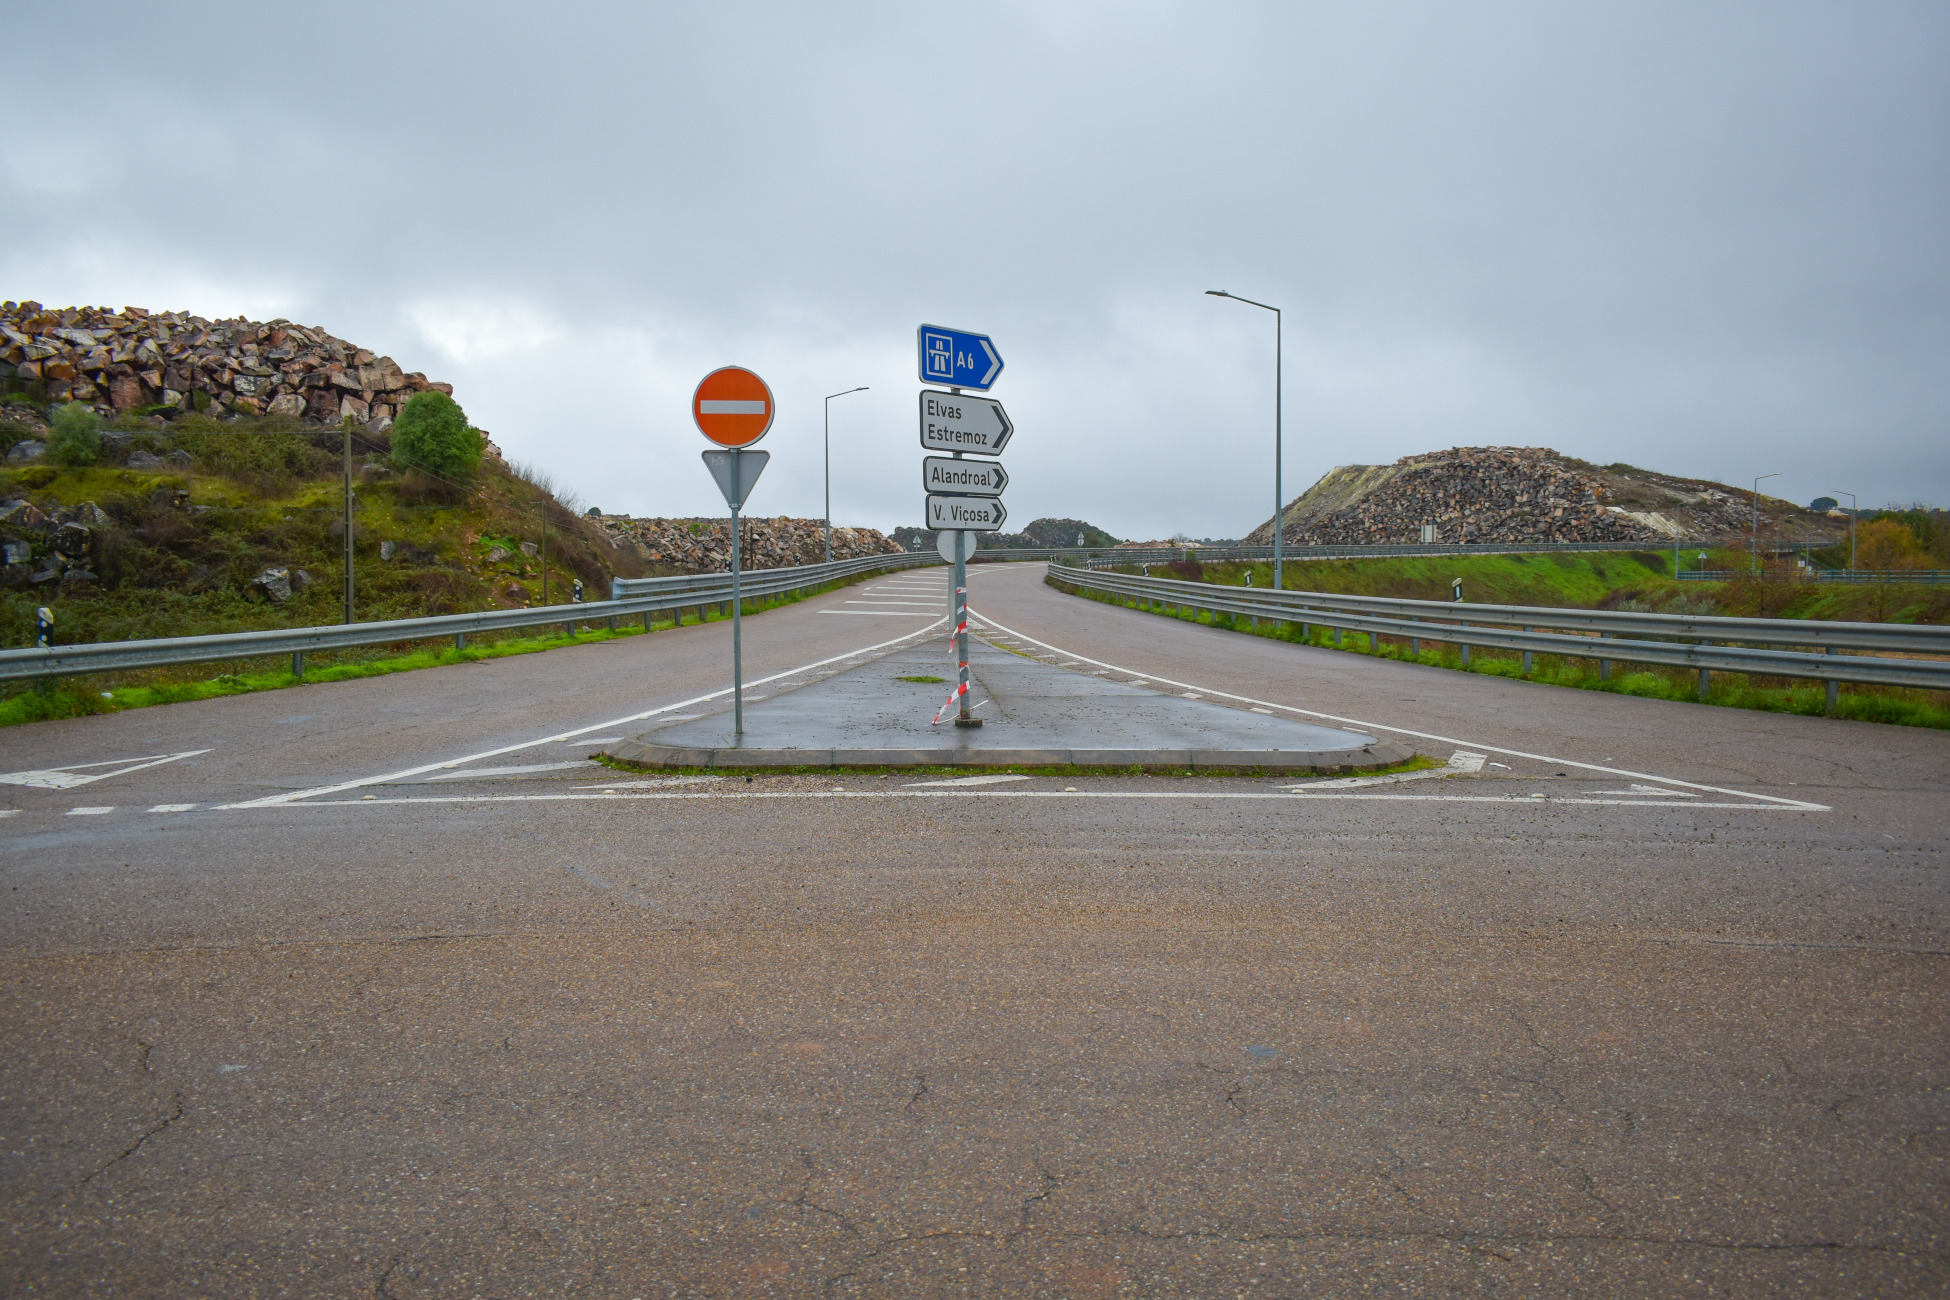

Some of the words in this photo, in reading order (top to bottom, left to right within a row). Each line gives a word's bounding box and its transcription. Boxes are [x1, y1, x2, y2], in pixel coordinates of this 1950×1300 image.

[957, 351, 974, 370] A6
[927, 399, 962, 419] Elvas
[928, 424, 987, 446] Estremoz
[932, 467, 991, 487] Alandroal
[933, 504, 946, 521] V.
[951, 505, 990, 526] Viçosa
